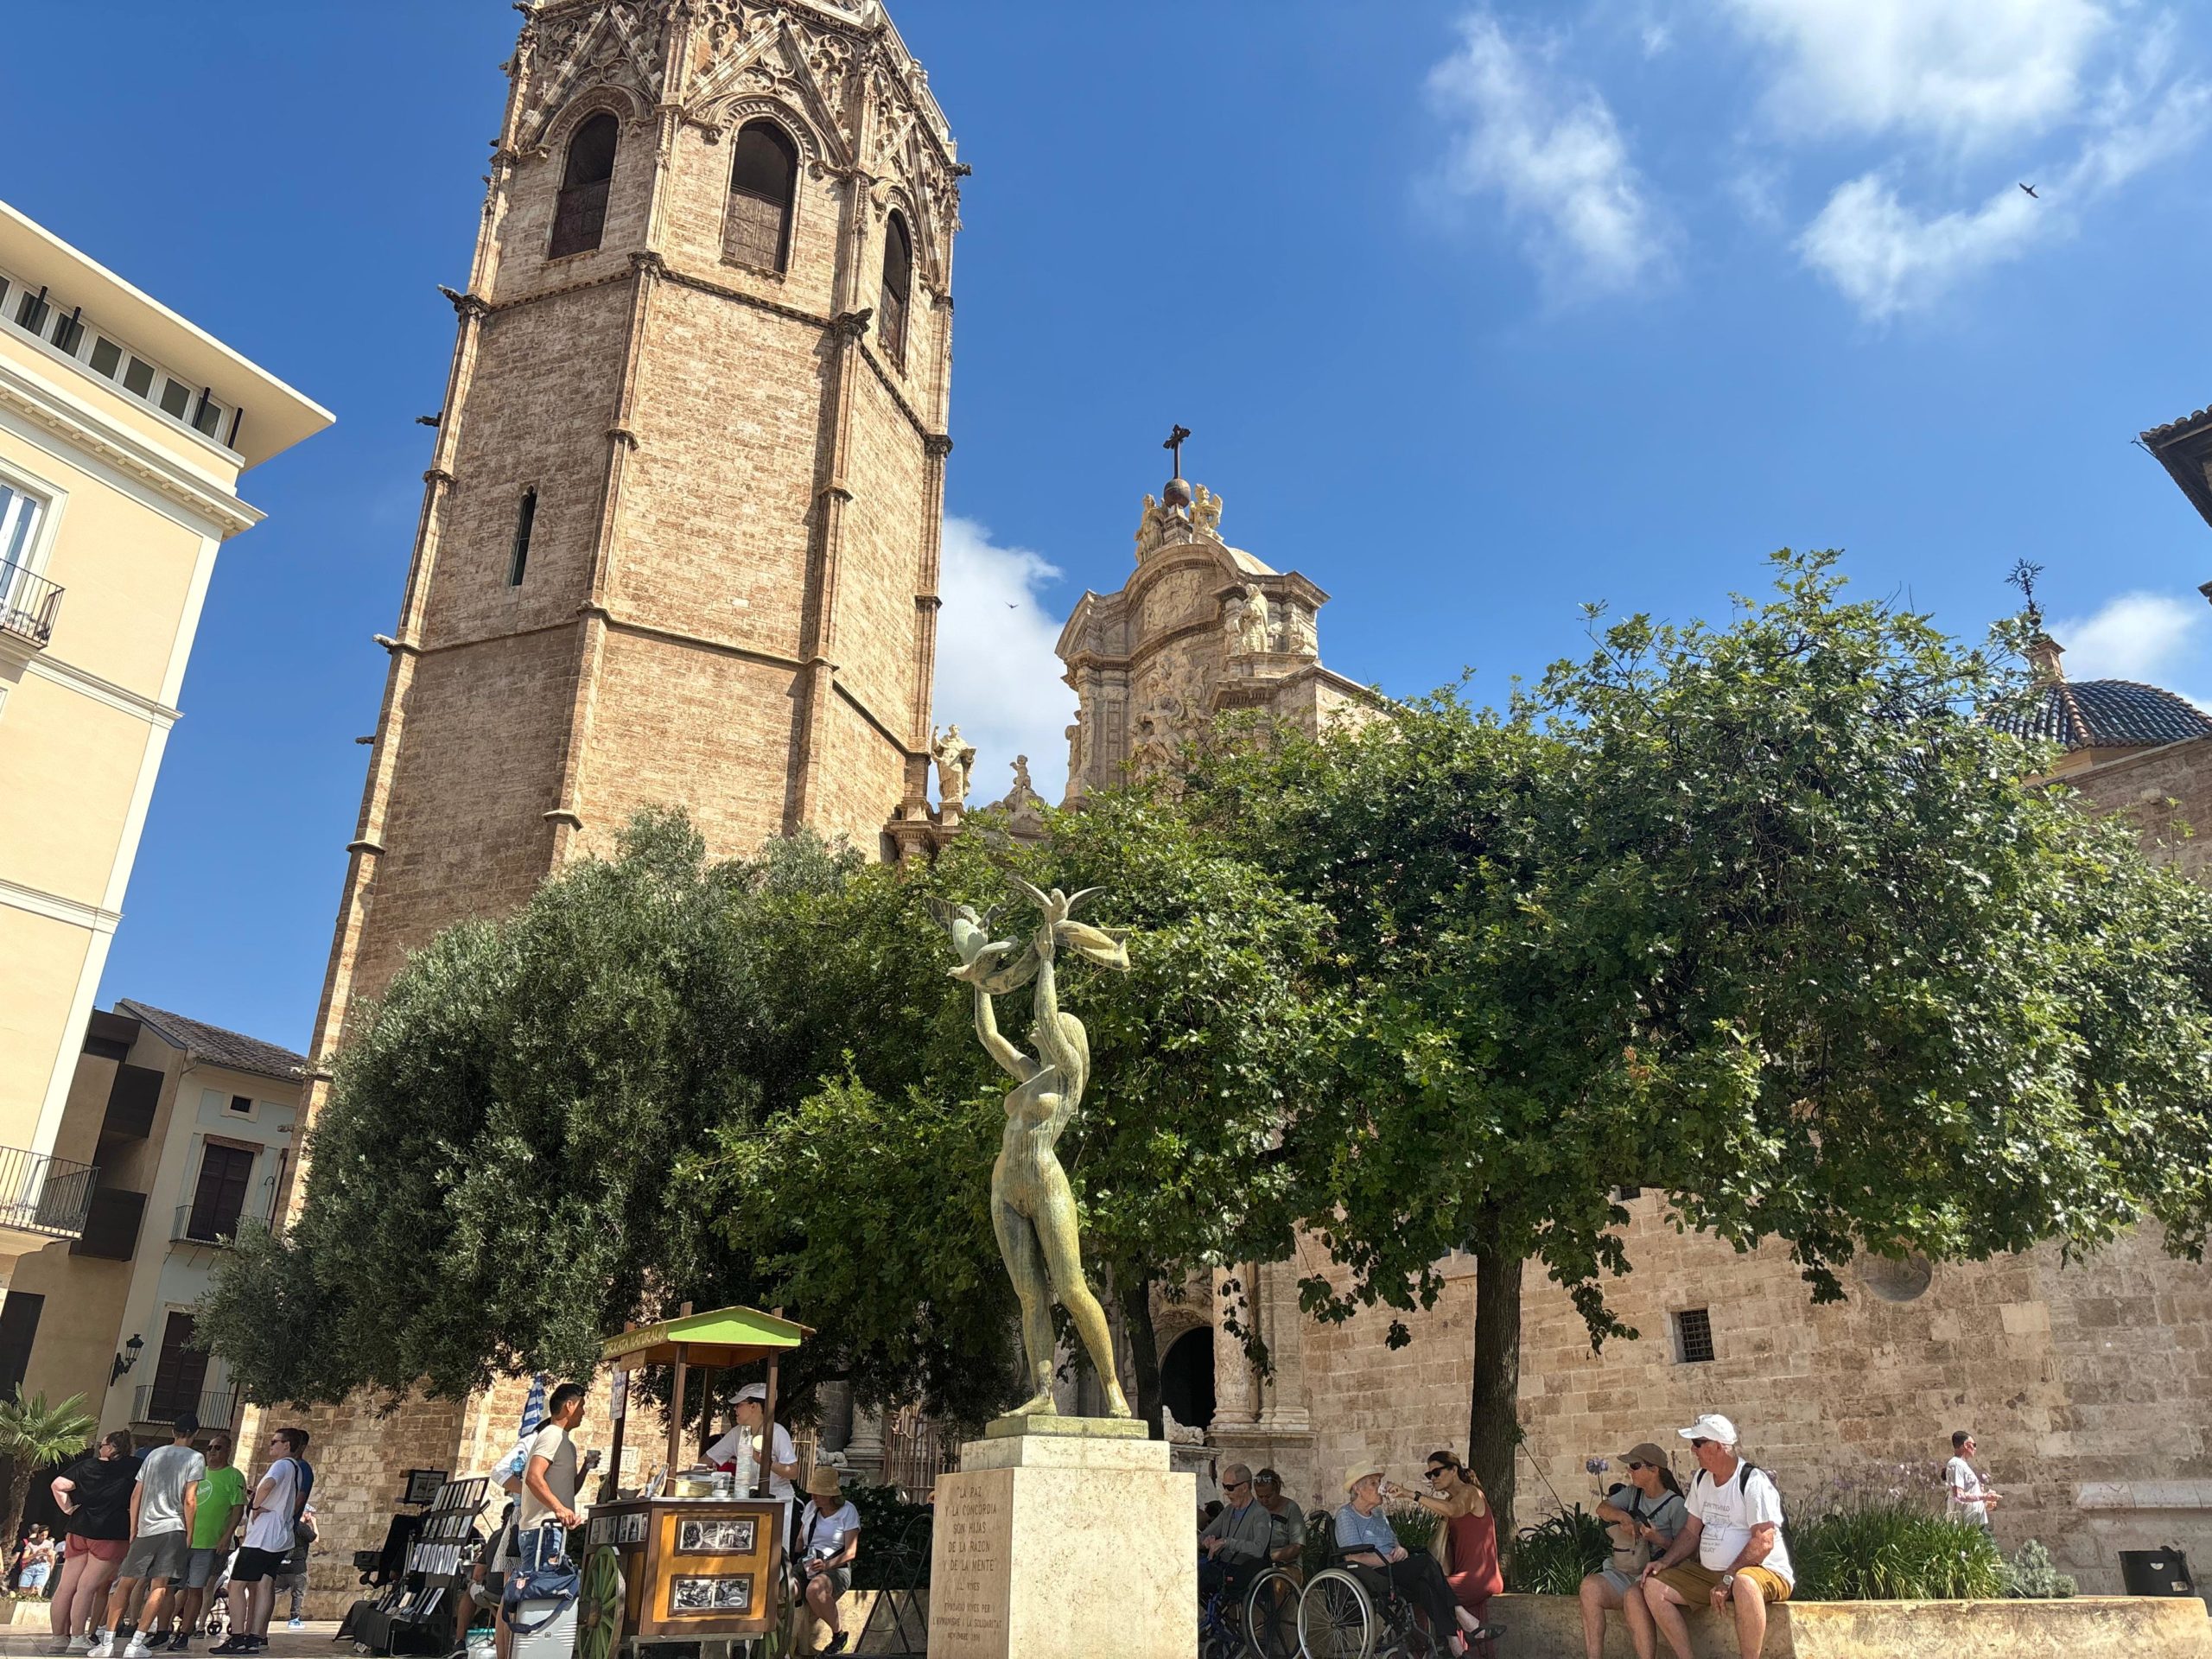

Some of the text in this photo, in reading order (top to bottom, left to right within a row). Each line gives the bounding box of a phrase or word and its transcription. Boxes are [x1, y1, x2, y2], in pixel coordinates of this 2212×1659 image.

[629, 1329, 658, 1348] NATURAL
[970, 1485, 982, 1497] PAZ
[945, 1503, 996, 1516] Y LA CONCORDIA
[953, 1521, 986, 1534] SON HIJAS
[948, 1541, 956, 1553] DE
[959, 1541, 966, 1553] LA
[943, 1560, 946, 1572] Y
[950, 1560, 958, 1570] DE
[962, 1560, 969, 1571] LA
